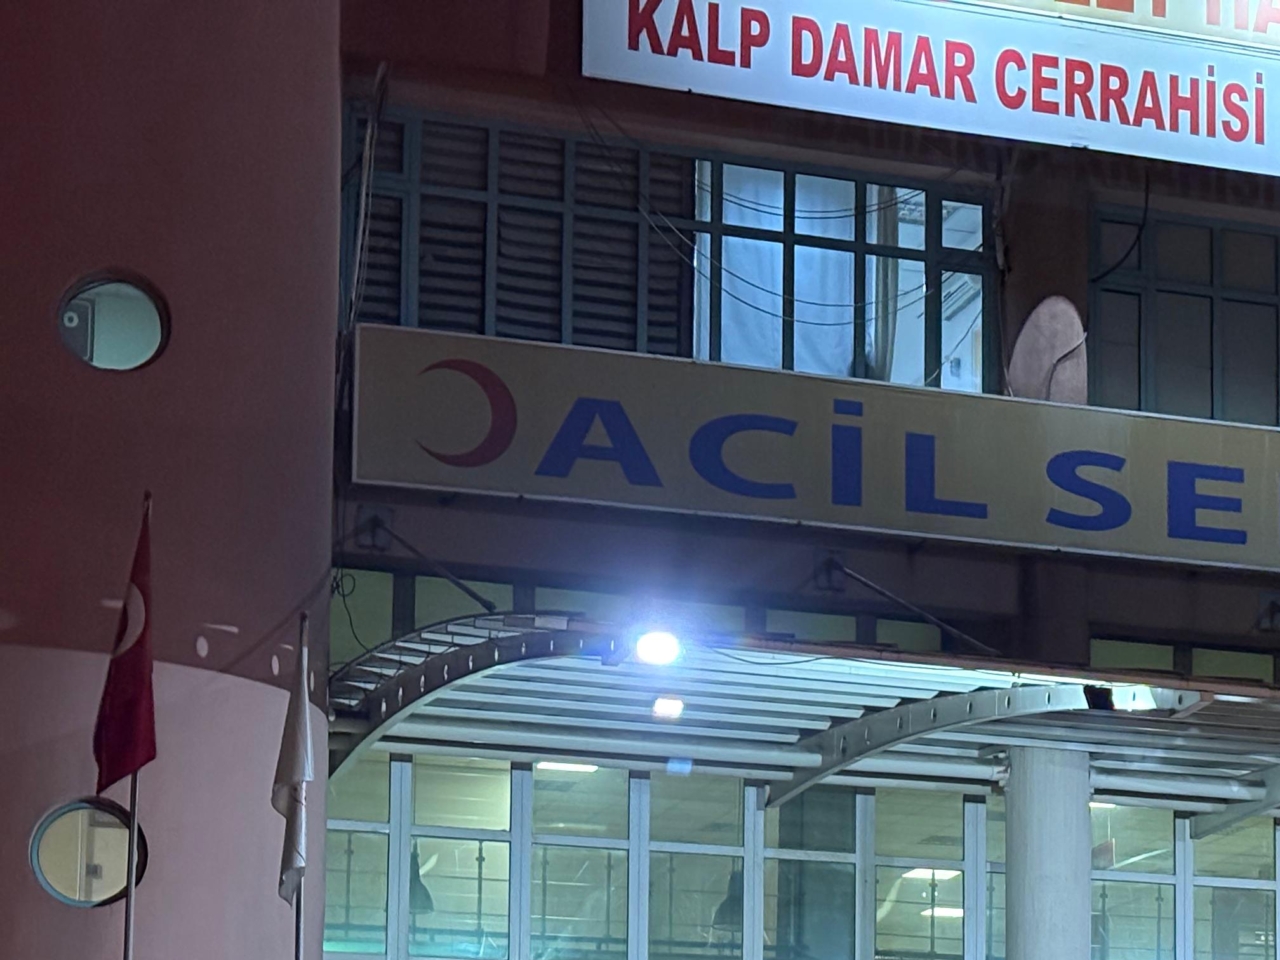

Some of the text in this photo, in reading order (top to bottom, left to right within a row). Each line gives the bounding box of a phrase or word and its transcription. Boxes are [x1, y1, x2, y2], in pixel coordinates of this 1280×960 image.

[628, 0, 770, 70] KALP
[791, 15, 977, 104] DAMAR
[994, 48, 1266, 146] CERRAHİSİ
[534, 396, 988, 520] ACİL
